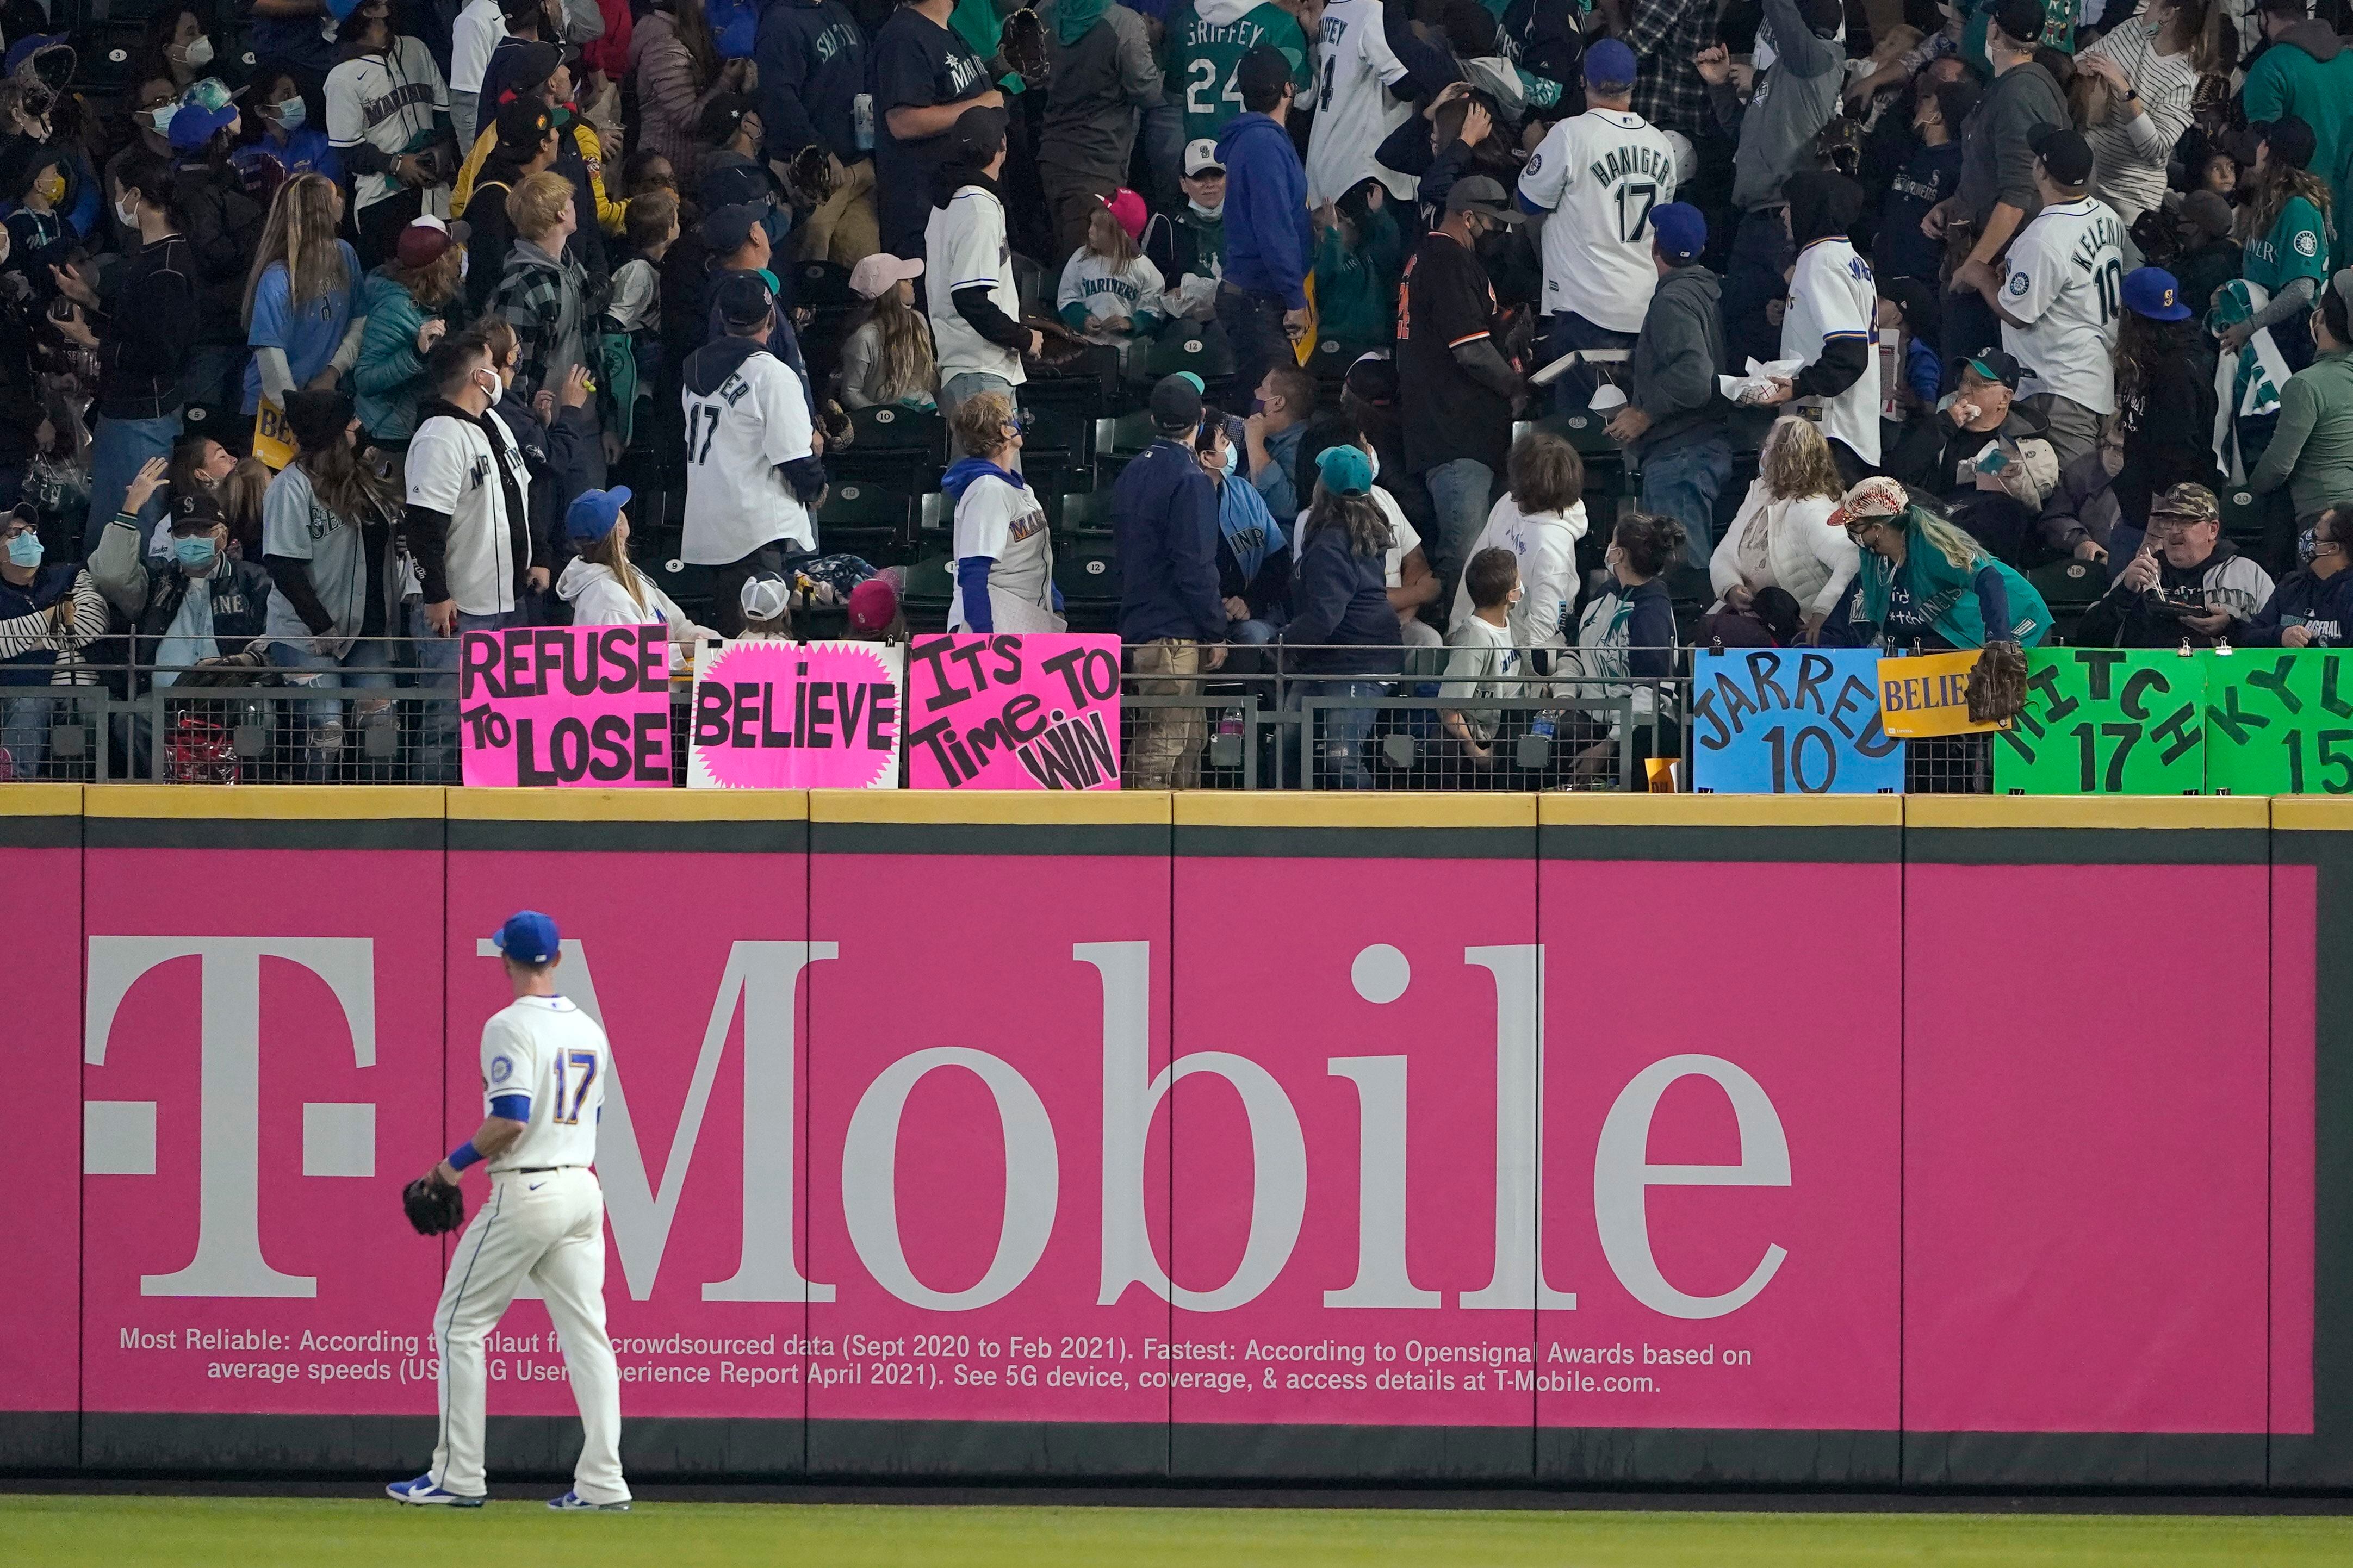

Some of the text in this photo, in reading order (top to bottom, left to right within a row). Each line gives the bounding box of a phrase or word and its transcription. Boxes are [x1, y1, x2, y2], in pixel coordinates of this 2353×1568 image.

[1589, 144, 1669, 189] HANIGER
[1613, 182, 1656, 245] 17
[1082, 277, 1138, 301] MARINERS
[2093, 256, 2124, 327] 10
[719, 371, 750, 409] ER
[687, 401, 722, 466] 17
[462, 625, 668, 699] REFUSE
[911, 633, 1120, 713] IT'S TO
[1998, 650, 2203, 766] MITCH
[2207, 654, 2353, 745] KYL
[462, 702, 669, 787] TO LOSE
[1761, 725, 1837, 793] 10
[2070, 723, 2143, 792] 17
[2281, 729, 2353, 794] 15
[553, 1047, 597, 1124] 17
[120, 1327, 177, 1349] Most
[186, 1328, 290, 1351] Reliable:
[299, 1329, 419, 1357] According
[610, 1333, 774, 1357] crowdsourced
[783, 1334, 835, 1357] data
[843, 1334, 905, 1361] (Sept
[913, 1335, 970, 1358] 2020
[978, 1338, 1001, 1358] to
[1010, 1336, 1052, 1359] Feb
[1060, 1336, 1133, 1364] 2021).
[1144, 1337, 1236, 1361] Fastest:
[1244, 1339, 1365, 1367] According
[1374, 1342, 1396, 1362] to
[1405, 1340, 1538, 1367] Opensignal
[1547, 1342, 1634, 1365] Awards
[1643, 1343, 1714, 1366] based
[1723, 1349, 1752, 1366] on
[207, 1362, 300, 1384] average
[308, 1358, 391, 1384] speeds
[720, 1361, 799, 1389] Report
[807, 1362, 861, 1389] April
[870, 1362, 943, 1390] 2021).
[954, 1364, 997, 1386] See
[1005, 1365, 1037, 1387] 5G
[1046, 1365, 1129, 1391] device,
[1139, 1369, 1252, 1393] coverage,
[1263, 1367, 1277, 1389] &
[1286, 1373, 1368, 1390] access
[1375, 1368, 1455, 1391] details
[1462, 1371, 1485, 1391] at
[1493, 1370, 1660, 1393] T-Mobile.com.
